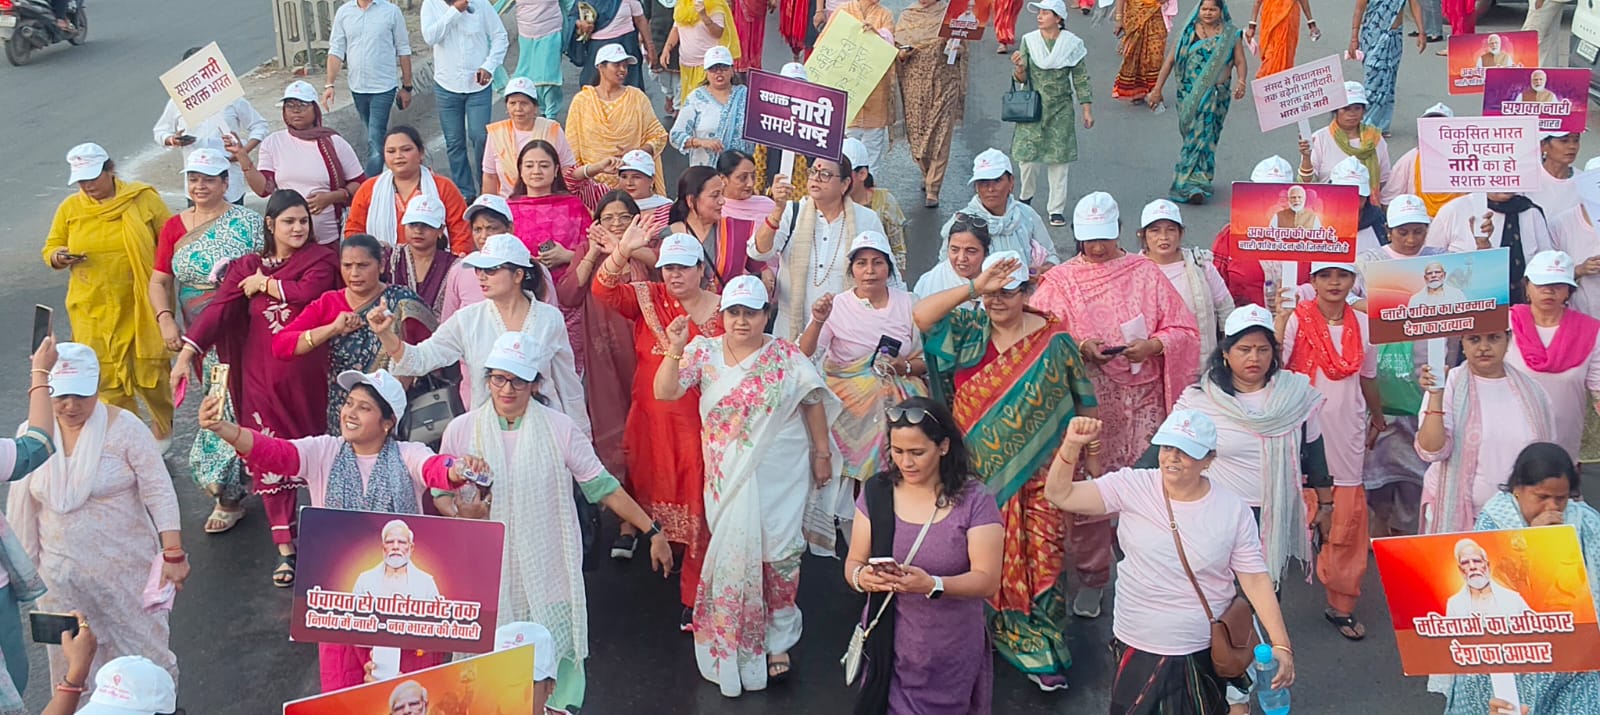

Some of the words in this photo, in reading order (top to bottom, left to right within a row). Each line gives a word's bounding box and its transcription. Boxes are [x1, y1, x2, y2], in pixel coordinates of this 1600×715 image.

[174, 73, 202, 96] सशक्त
[198, 57, 222, 80] नारी
[1264, 81, 1283, 92] संसद
[1284, 76, 1291, 86] से
[184, 86, 211, 111] सशक्त
[208, 73, 233, 94] भारत
[1264, 92, 1278, 103] तक
[759, 89, 790, 106] सशक्त
[790, 97, 834, 126] नारी
[1280, 107, 1300, 118] भारत
[1300, 101, 1311, 112] की
[1313, 95, 1329, 108] नारी
[1501, 101, 1540, 115] सशक्त
[1541, 98, 1572, 115] नारी
[760, 113, 797, 136] समर्थ
[797, 122, 829, 149] राष्ट्र
[1438, 125, 1489, 140] विकसित
[1493, 127, 1523, 139] भारत
[1452, 140, 1469, 155] की
[1473, 142, 1514, 156] पहचान
[1447, 154, 1479, 172] नारी
[1482, 160, 1499, 171] का
[1502, 156, 1517, 173] हो
[1449, 175, 1486, 187] सशक्त
[1489, 175, 1520, 187] स्थान
[1248, 226, 1264, 238] अब
[1290, 225, 1305, 238] की
[1305, 226, 1326, 240] बारी
[1381, 304, 1407, 320] नारी
[1407, 304, 1437, 318] शक्ति
[1437, 303, 1453, 316] का
[1453, 298, 1496, 314] सम्मान
[1403, 320, 1423, 336] देश
[1424, 321, 1439, 333] का
[307, 586, 355, 611] पंचायत
[356, 591, 375, 613] से
[375, 593, 452, 618] पार्लियामेंट
[452, 602, 481, 619] तक
[306, 610, 339, 628] निर्णय
[339, 613, 352, 629] में
[352, 616, 379, 632] नारी
[387, 618, 407, 634] नव
[407, 620, 435, 636] भारत
[435, 620, 451, 637] की
[451, 620, 481, 639] तैयारी
[1413, 612, 1484, 637] महिलाओं
[1485, 616, 1508, 634] का
[1509, 610, 1574, 633] अधिकार
[1450, 639, 1481, 665] देश
[1481, 644, 1500, 664] का
[1502, 643, 1552, 663] आधार
